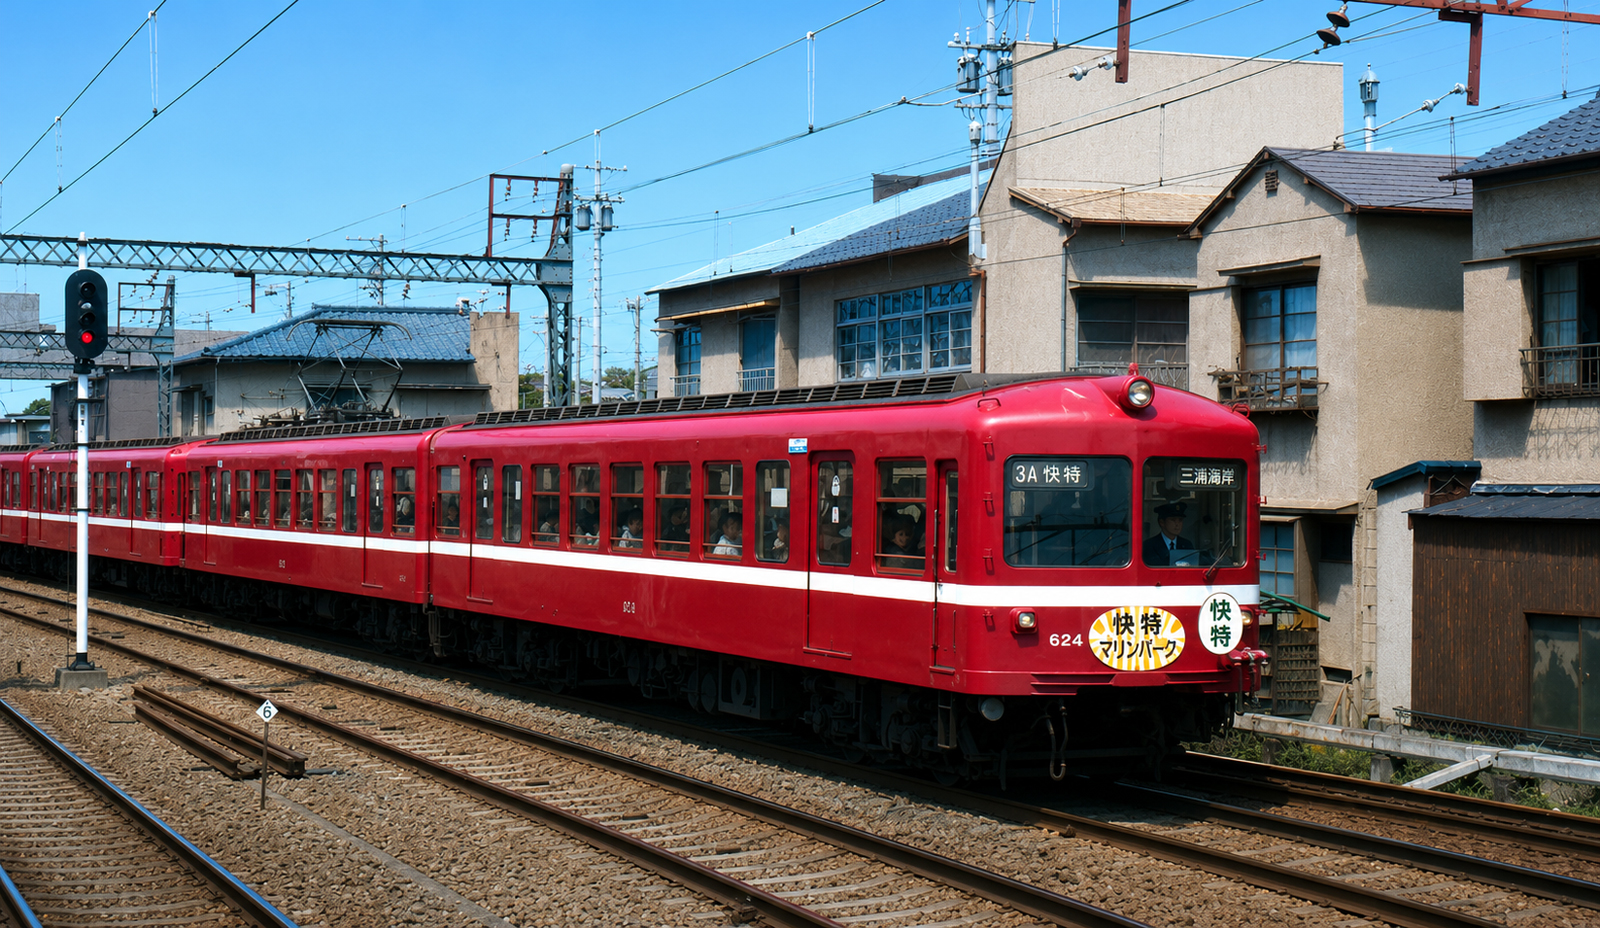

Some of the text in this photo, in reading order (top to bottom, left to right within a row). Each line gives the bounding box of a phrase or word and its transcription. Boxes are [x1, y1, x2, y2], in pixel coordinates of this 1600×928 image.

[1015, 464, 1081, 484] 3A 快特
[1112, 612, 1162, 636] 快特
[1209, 598, 1232, 648] 快特
[1049, 633, 1084, 647] 624
[263, 705, 272, 719] 6
